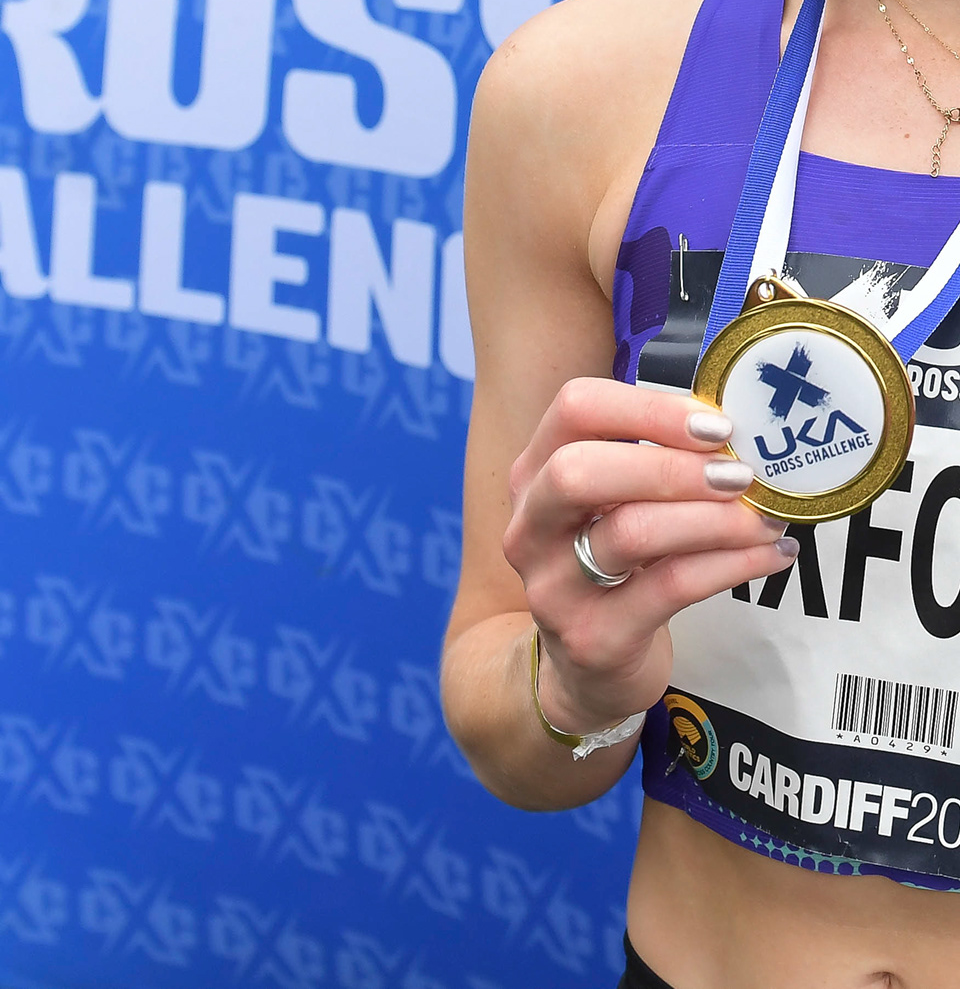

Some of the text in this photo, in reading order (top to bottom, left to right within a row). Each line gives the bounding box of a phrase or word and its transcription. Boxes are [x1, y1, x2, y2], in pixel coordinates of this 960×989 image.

[754, 409, 867, 461] UKA
[765, 433, 873, 478] CROSS CHALLENGE
